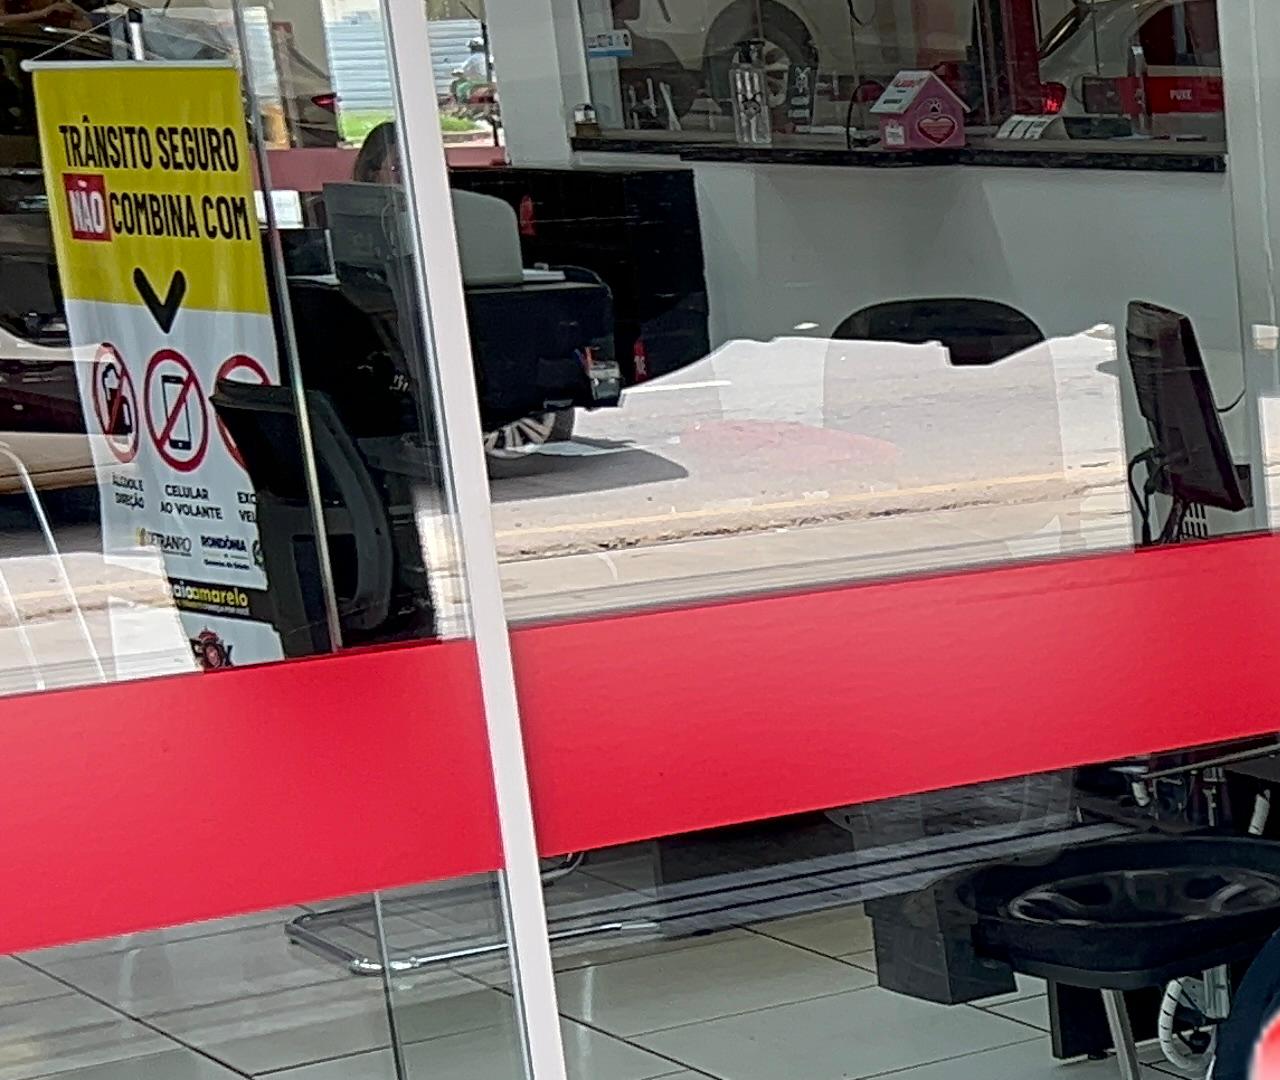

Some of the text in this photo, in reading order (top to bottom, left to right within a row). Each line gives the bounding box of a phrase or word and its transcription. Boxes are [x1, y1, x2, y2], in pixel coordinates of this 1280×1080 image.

[59, 115, 239, 173] TRÂNSITO SEGURO
[69, 179, 251, 240] NÃO COMBINA COM
[165, 484, 209, 500] CELULAR
[160, 502, 223, 520] AO VOLANTE
[174, 580, 248, 607] aioamarelo
